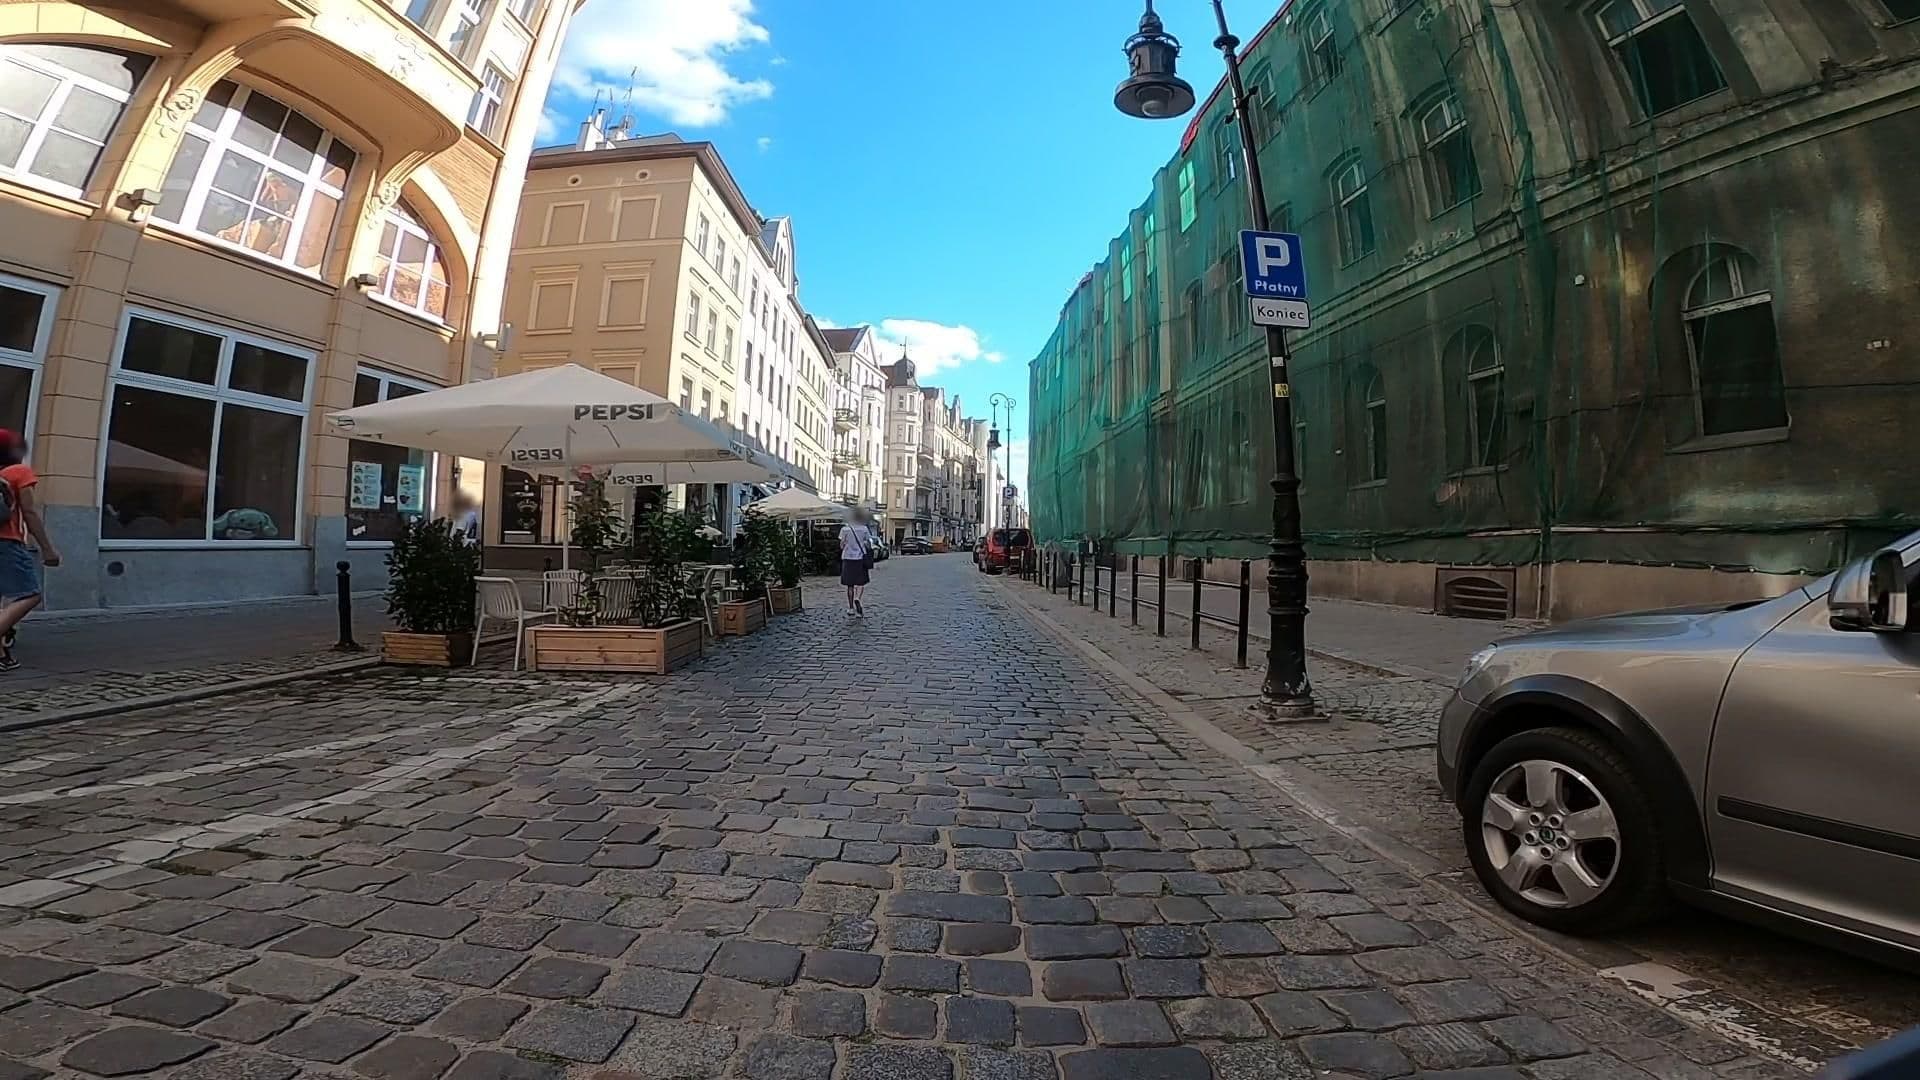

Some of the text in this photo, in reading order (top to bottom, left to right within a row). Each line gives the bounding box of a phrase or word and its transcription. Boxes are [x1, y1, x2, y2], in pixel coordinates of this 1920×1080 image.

[1255, 237, 1290, 276] P
[1255, 280, 1297, 296] Płatny
[1257, 305, 1304, 320] Koniec
[574, 404, 653, 420] PEPSI
